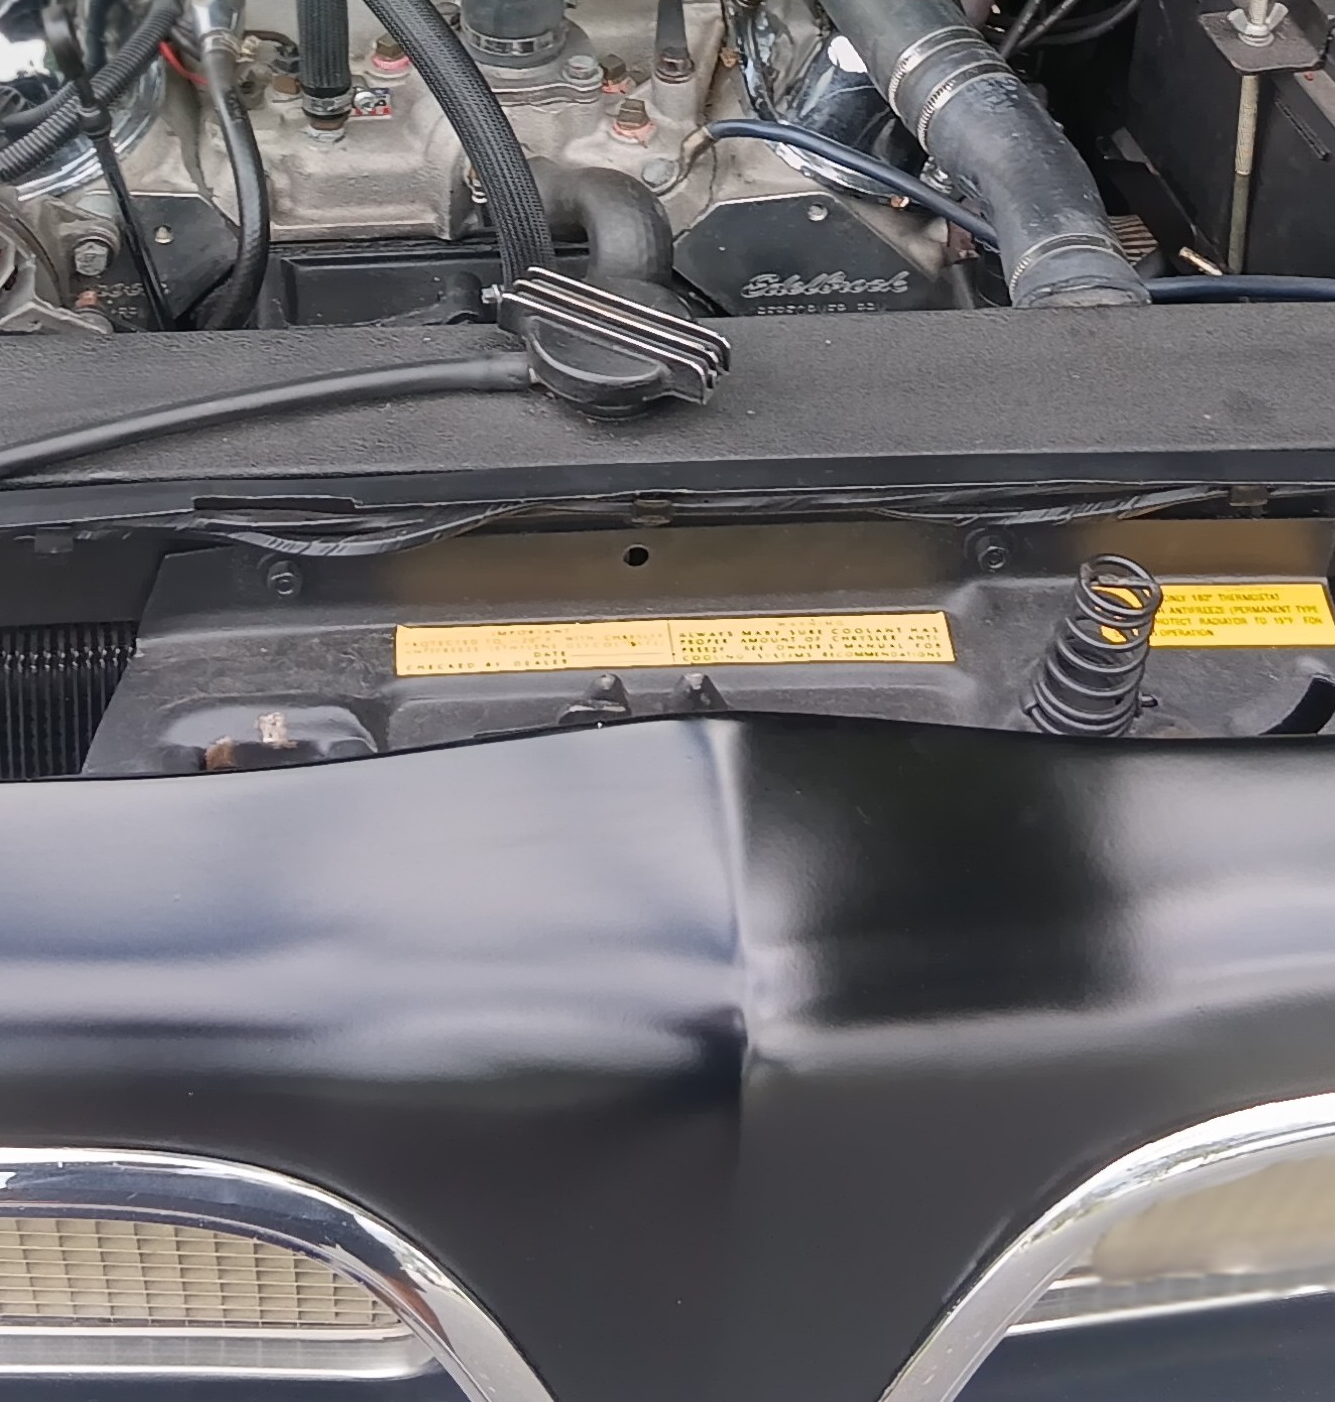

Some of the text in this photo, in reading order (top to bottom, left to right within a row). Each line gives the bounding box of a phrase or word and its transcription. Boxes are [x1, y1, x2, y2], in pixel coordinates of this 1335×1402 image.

[1218, 593, 1280, 602] THERMOSTAT
[1169, 606, 1225, 614] ANTIFREEZE
[1199, 617, 1248, 626] RADIATOR
[679, 630, 734, 638] ALWAYS
[790, 628, 823, 636] SURE
[831, 627, 902, 635] COOLANT
[910, 626, 939, 634] HAS
[1159, 628, 1215, 637] OPERATION
[680, 638, 729, 646] PROPER
[740, 636, 796, 645] AMOUNT
[832, 634, 897, 643] CHRYSLER
[844, 642, 904, 650] MANUAL
[915, 641, 942, 650] FOR
[534, 650, 567, 658] DATE
[822, 650, 943, 659] RECOMMENDATIONS
[406, 661, 476, 671] CHECKED
[514, 658, 568, 668] DEALER
